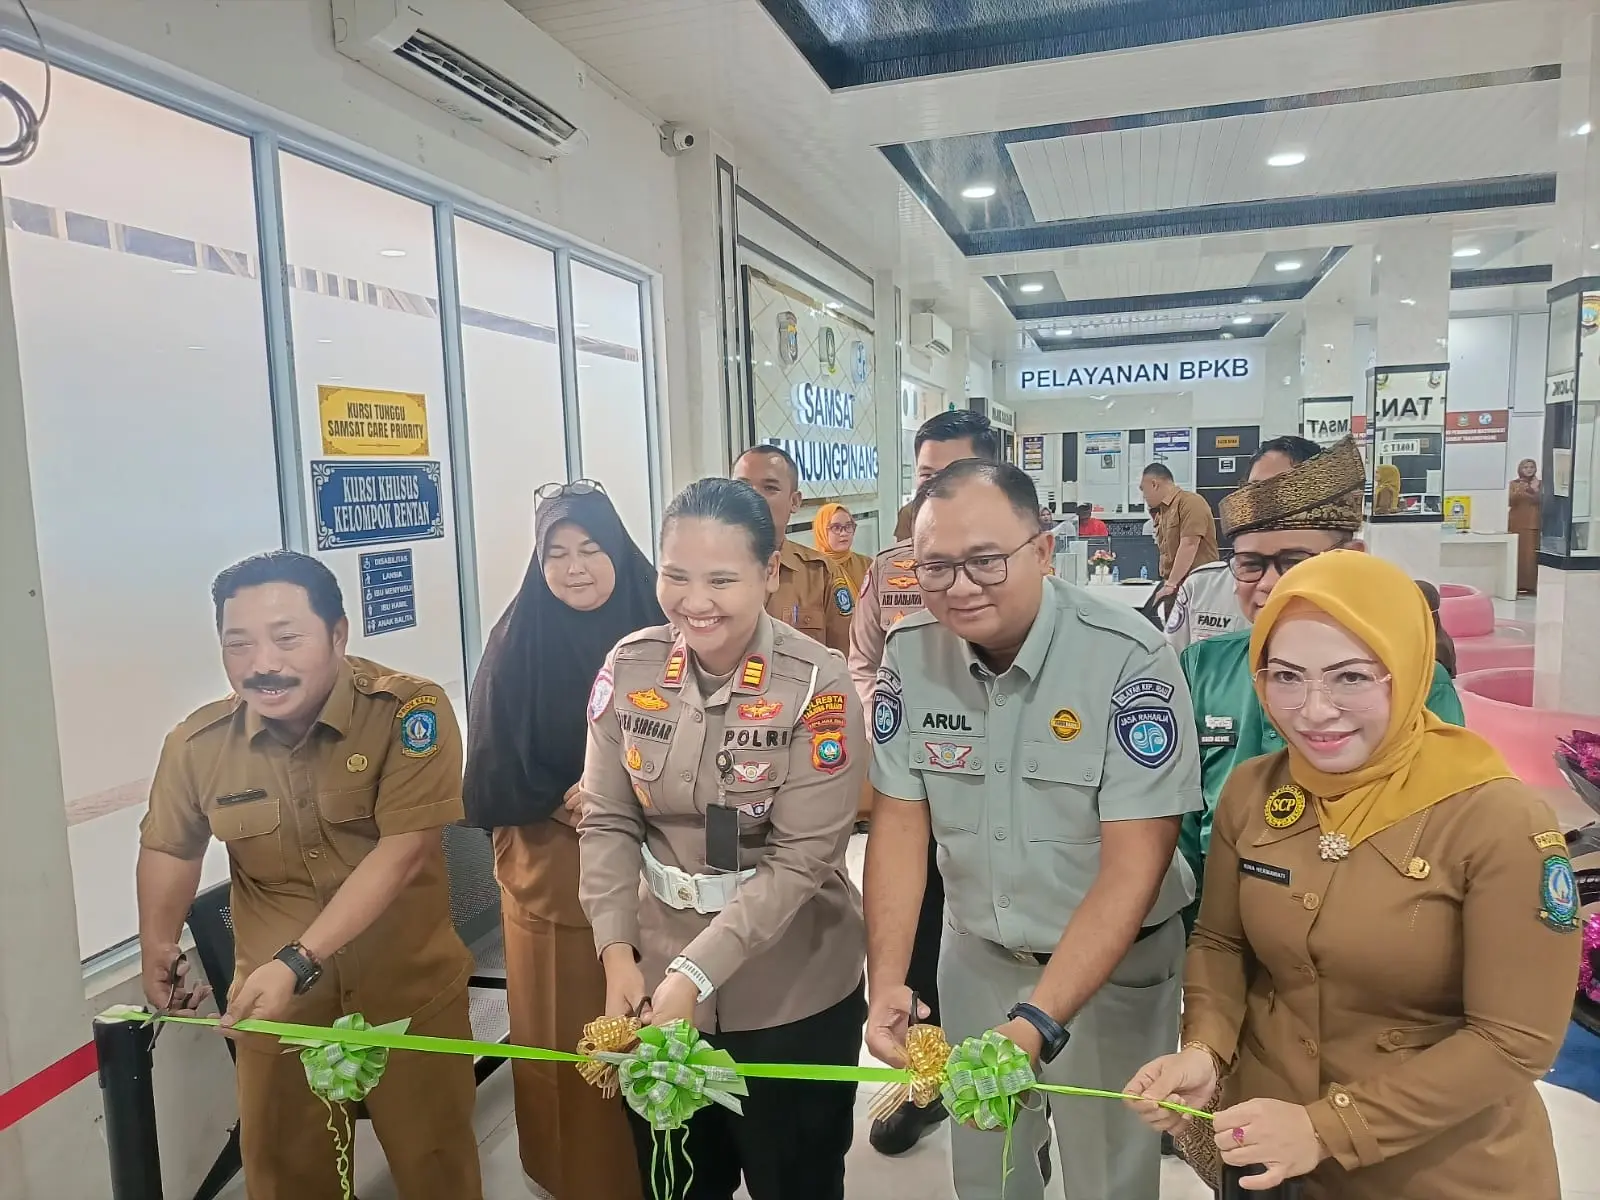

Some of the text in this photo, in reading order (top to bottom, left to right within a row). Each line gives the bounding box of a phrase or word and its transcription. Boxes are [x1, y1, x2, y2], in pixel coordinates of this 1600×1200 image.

[1021, 358, 1249, 388] PELAYANAN BPKB
[347, 402, 405, 421] KURSI TUNGGU
[803, 382, 855, 429] SAMSAT
[328, 420, 423, 439] SAMSAT CARE PRIORITY
[770, 439, 878, 481] ANJUNGPINANG
[343, 475, 419, 503] KURSI KHUSUS
[333, 501, 430, 533] KELOMPOK RENTAN
[374, 588, 384, 597] IBU
[377, 618, 394, 628] ANAK
[1198, 615, 1231, 628] FADLY
[1117, 685, 1141, 702] WILAYAH
[806, 695, 844, 711] OLRESTA
[633, 717, 672, 740] SIREGAR
[922, 712, 972, 730] ARUL
[1121, 713, 1169, 726] JASA RAHARJA
[724, 729, 788, 747] POLRI
[1271, 798, 1296, 811] SCP
